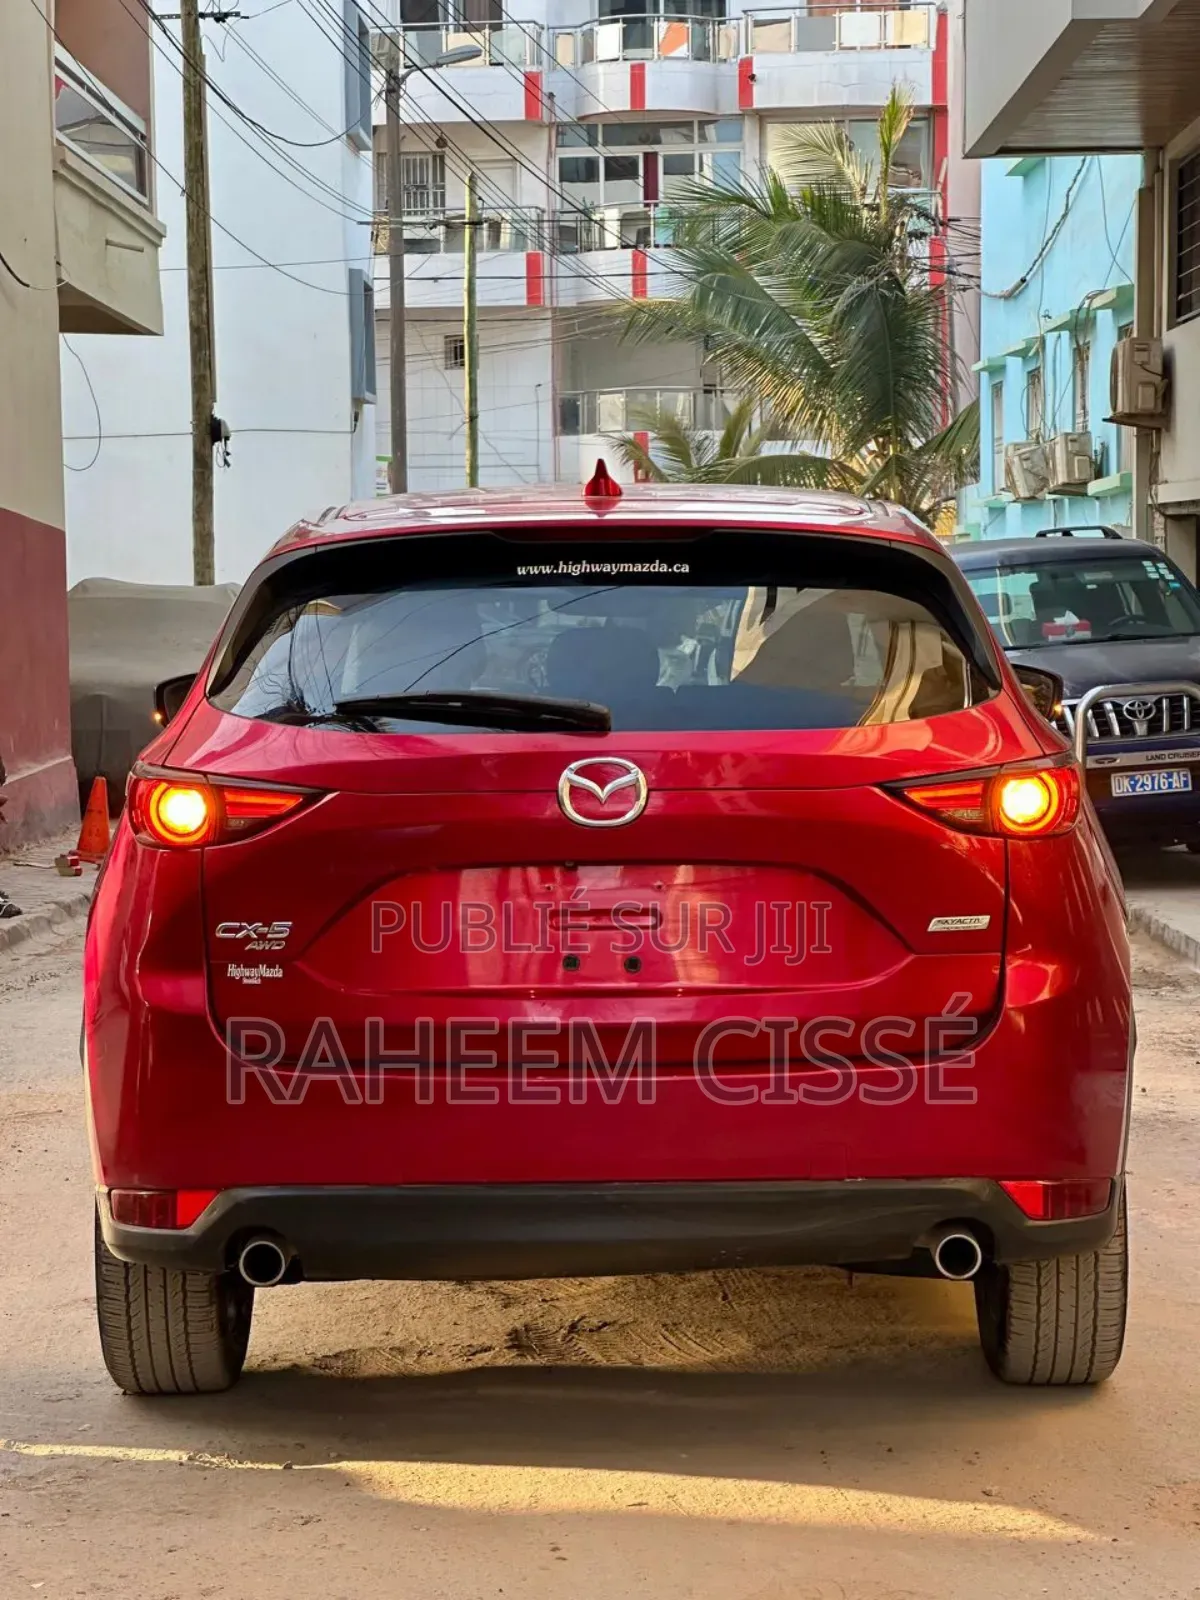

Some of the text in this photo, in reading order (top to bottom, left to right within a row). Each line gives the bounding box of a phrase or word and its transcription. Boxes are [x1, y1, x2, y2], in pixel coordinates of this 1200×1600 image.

[516, 560, 690, 576] www.highwaymazda.ca
[1146, 753, 1166, 761] LAND
[1114, 771, 1188, 793] DK-2976-AF
[214, 921, 293, 939] CX-5
[244, 940, 286, 951] AWD
